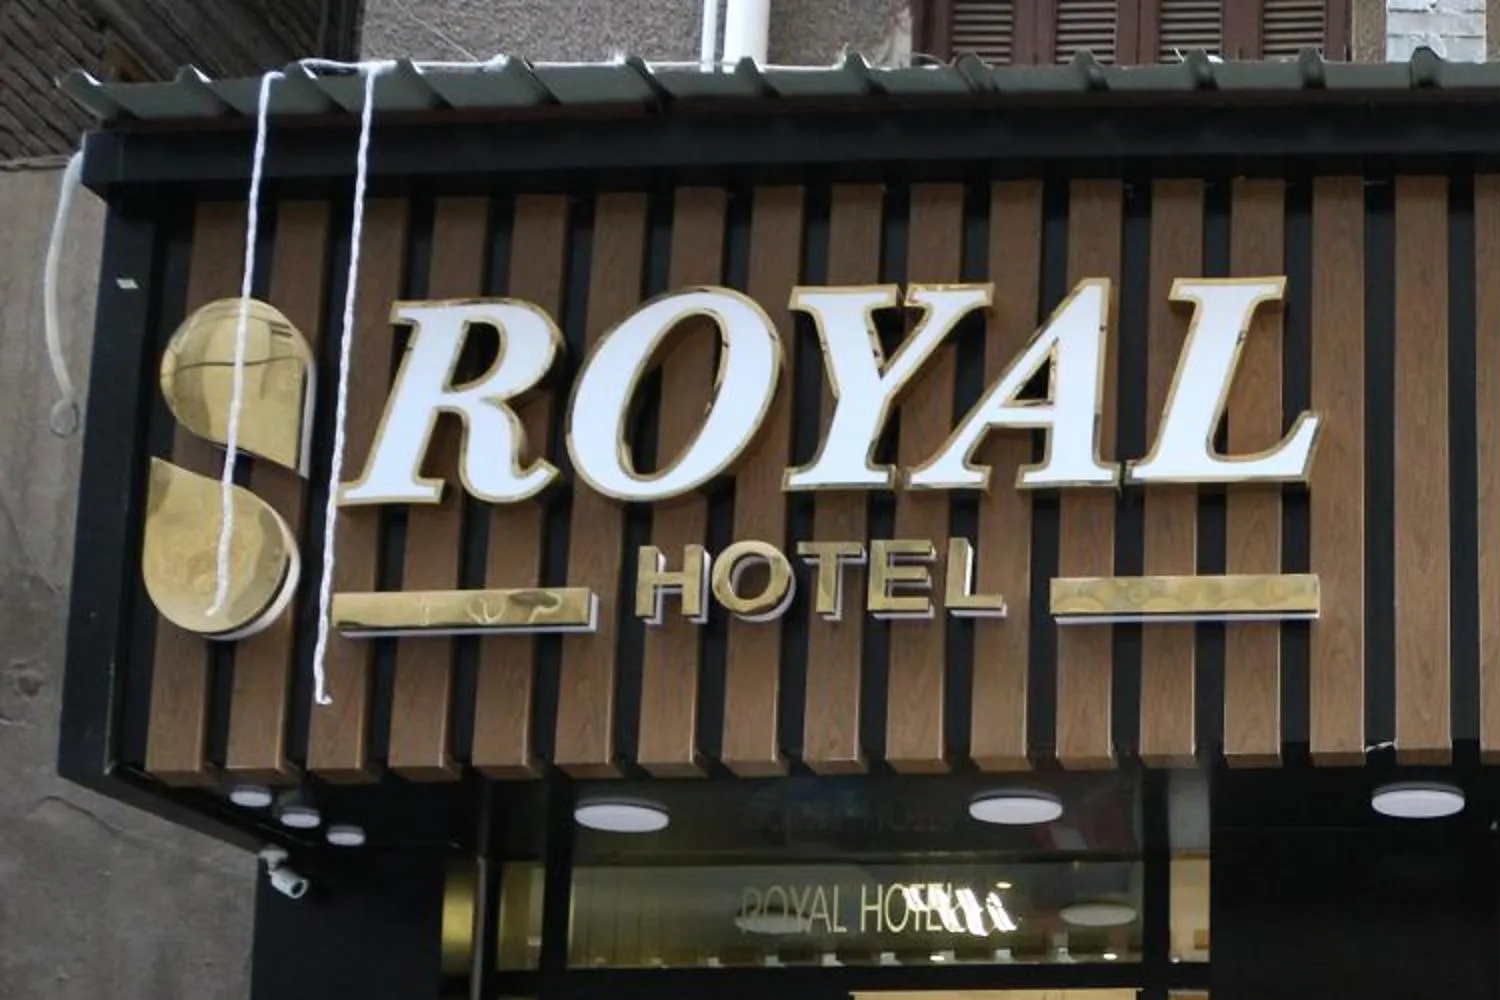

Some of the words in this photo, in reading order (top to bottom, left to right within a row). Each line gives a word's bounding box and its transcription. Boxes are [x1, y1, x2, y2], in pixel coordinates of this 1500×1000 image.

[334, 276, 1319, 505] ROYAL
[634, 538, 1007, 622] HOTEL
[742, 884, 847, 934] ROYAL
